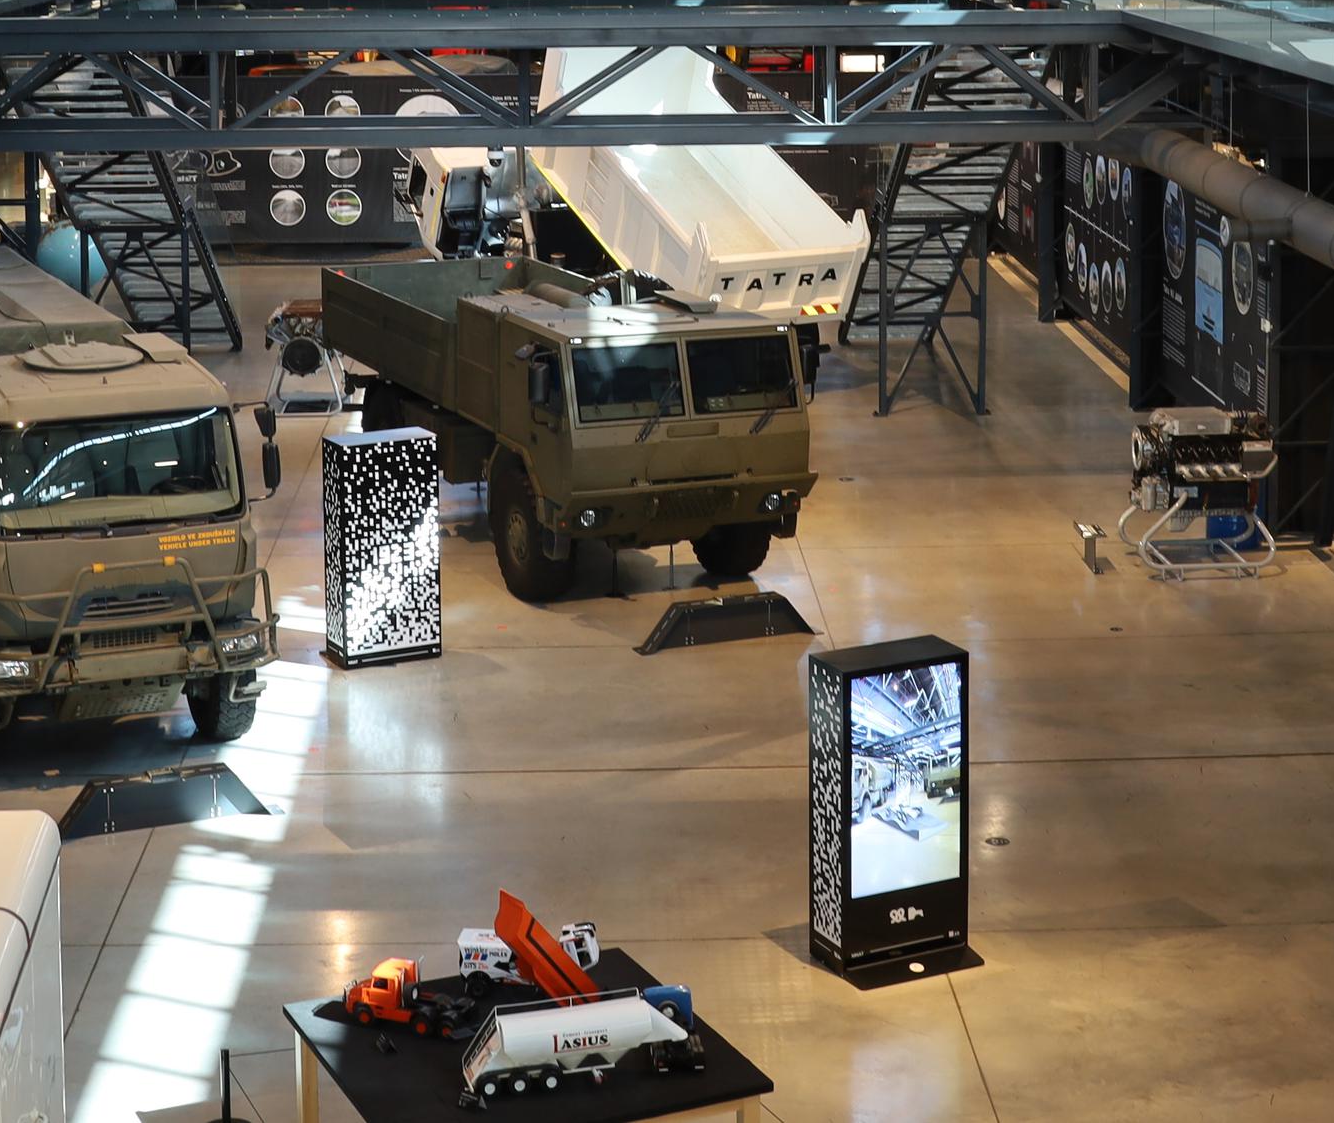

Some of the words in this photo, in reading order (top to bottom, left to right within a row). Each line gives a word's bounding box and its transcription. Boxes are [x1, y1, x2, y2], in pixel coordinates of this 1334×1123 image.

[392, 172, 409, 180] Tatr
[720, 268, 837, 292] TATRA
[158, 542, 187, 551] VEHICLE
[188, 540, 211, 548] UNDER
[213, 536, 236, 545] TRIALS
